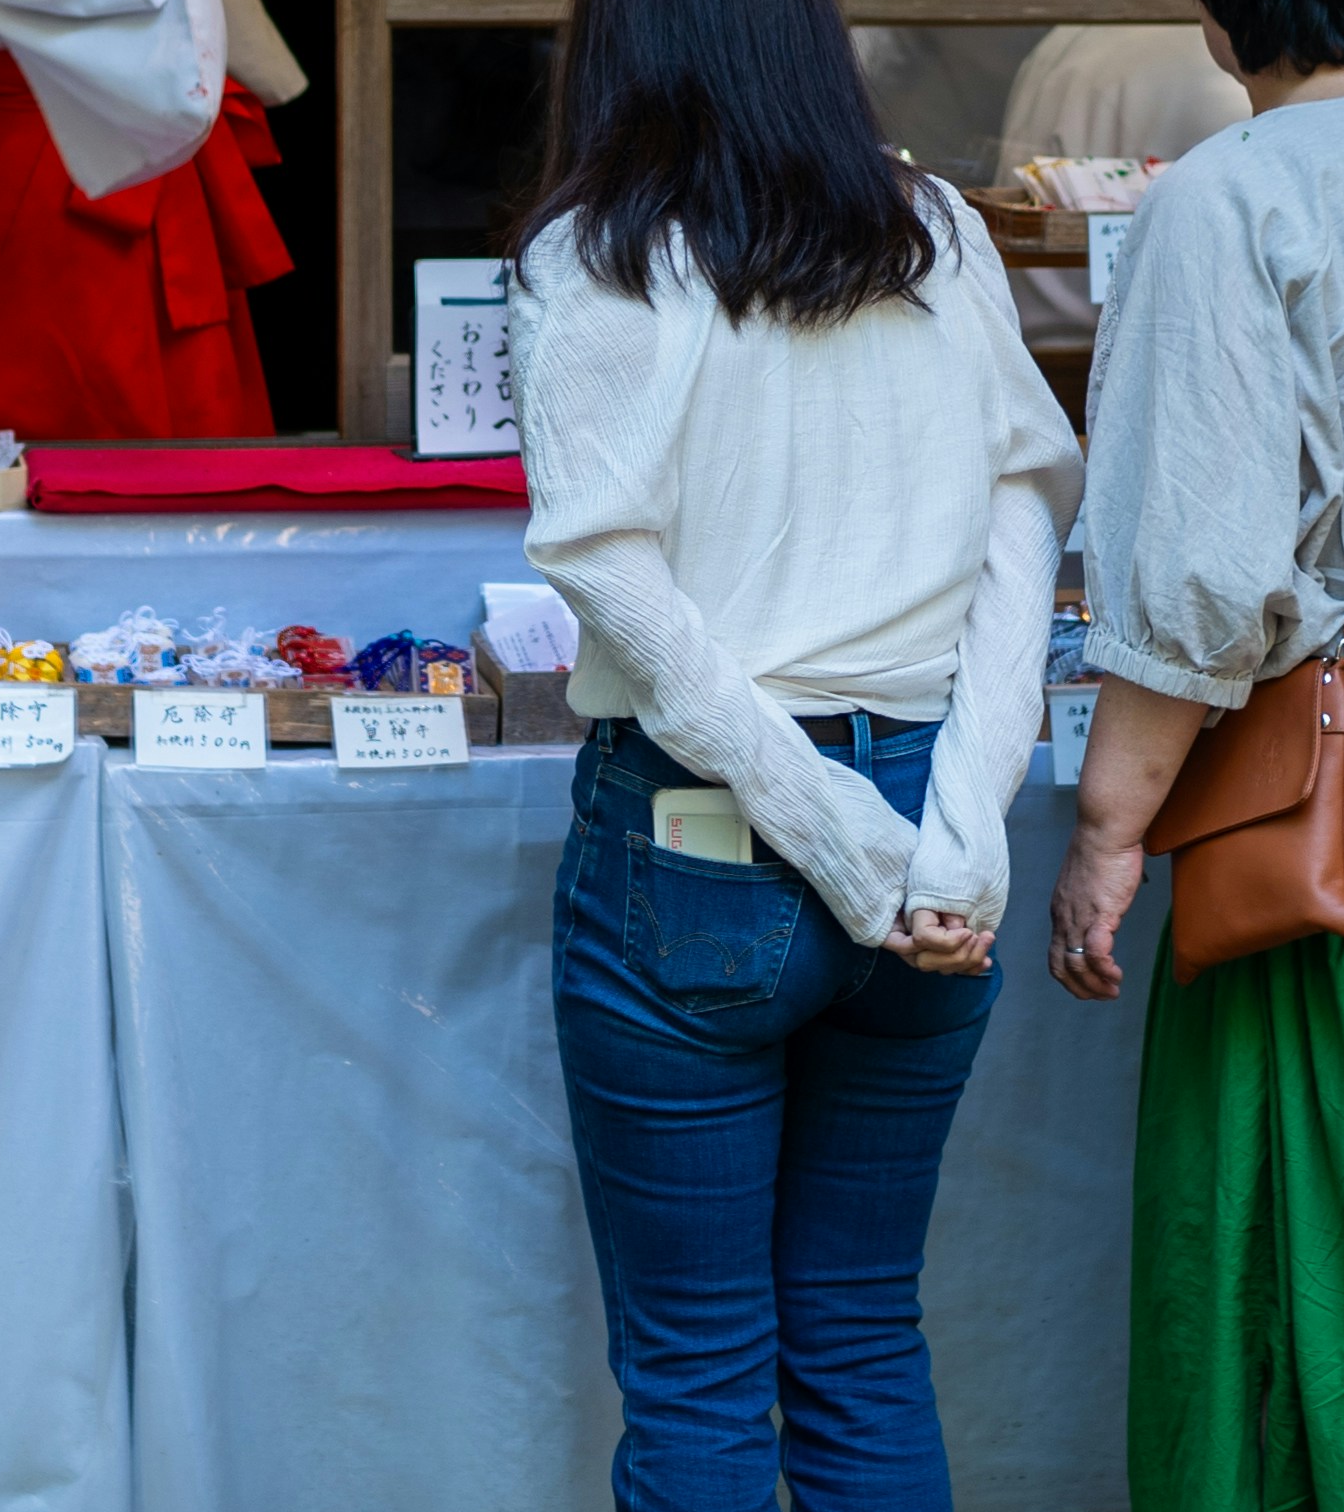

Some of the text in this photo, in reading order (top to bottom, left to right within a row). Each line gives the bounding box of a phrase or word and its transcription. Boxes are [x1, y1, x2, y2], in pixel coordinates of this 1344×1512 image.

[430, 339, 452, 428] ください
[462, 320, 482, 433] おまわり
[162, 705, 238, 725] 厄除守
[25, 735, 63, 752] 500円
